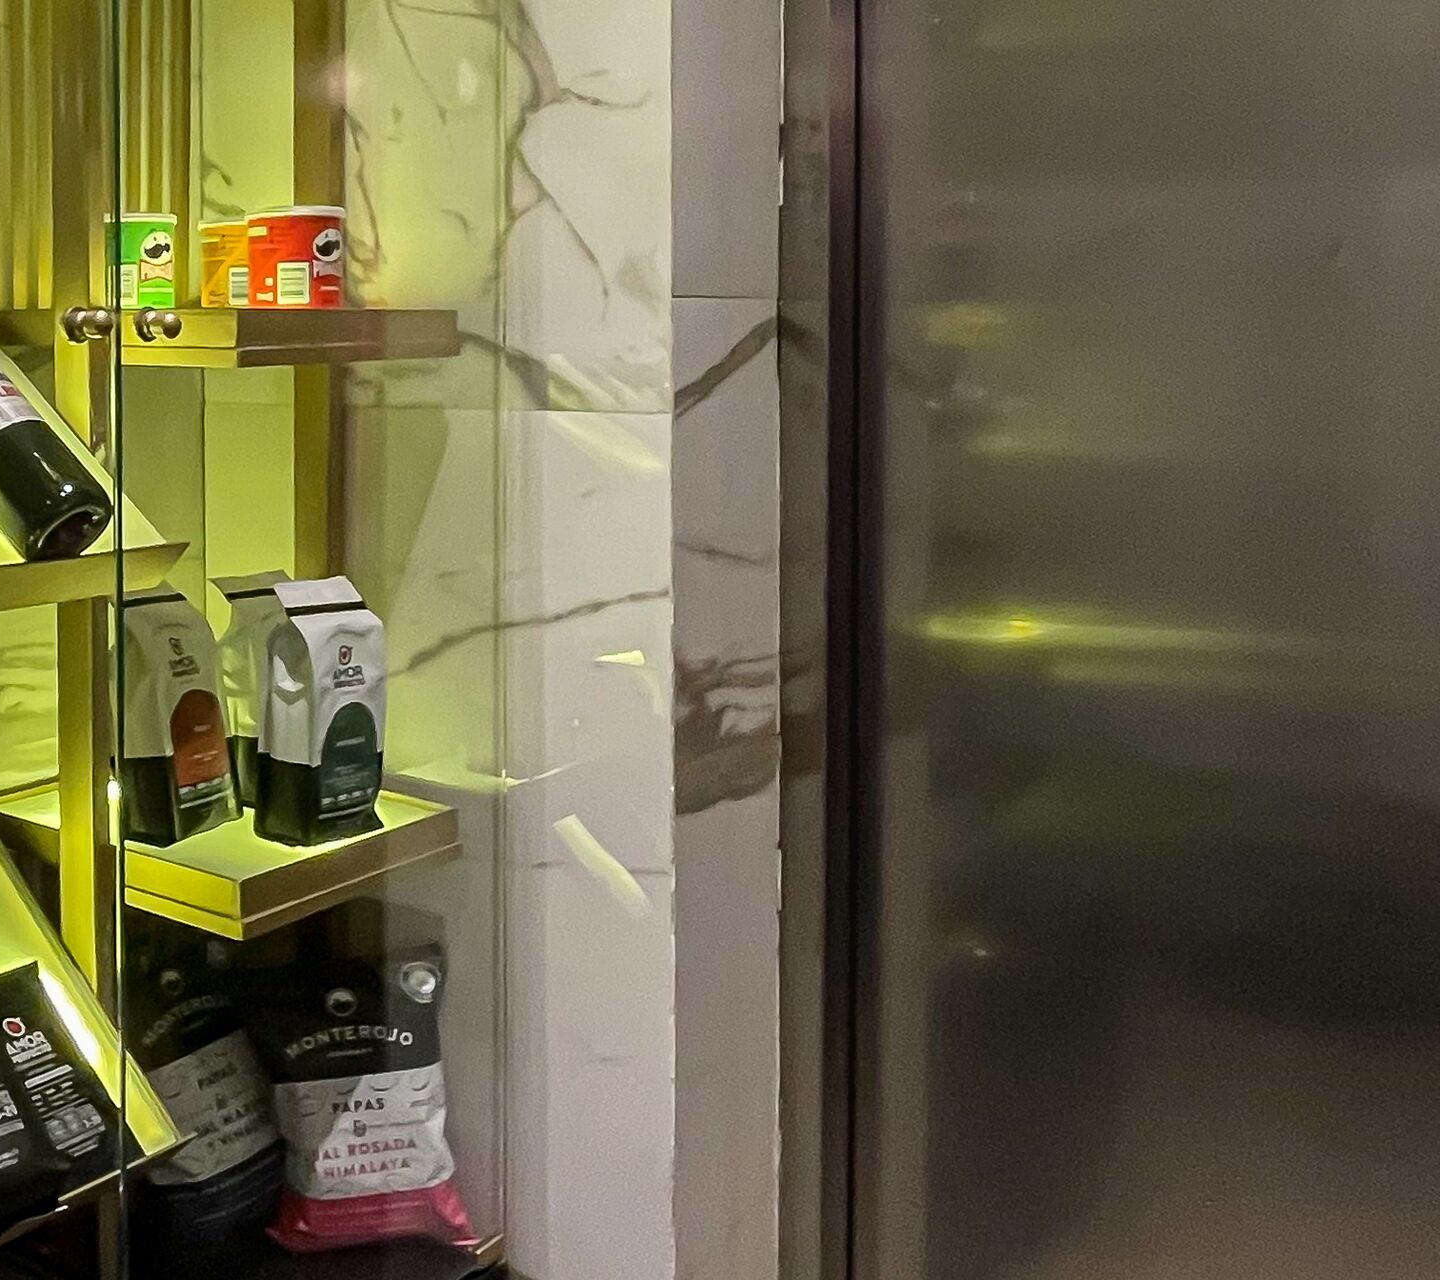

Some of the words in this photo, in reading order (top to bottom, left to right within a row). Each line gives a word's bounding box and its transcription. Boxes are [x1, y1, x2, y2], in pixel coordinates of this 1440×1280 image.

[5, 1030, 47, 1055] AMOR
[284, 1024, 414, 1059] MONTEROJO
[331, 1097, 386, 1115] PAPAS
[347, 1138, 418, 1157] ROSADA
[323, 1157, 412, 1179] HIMALAYA
